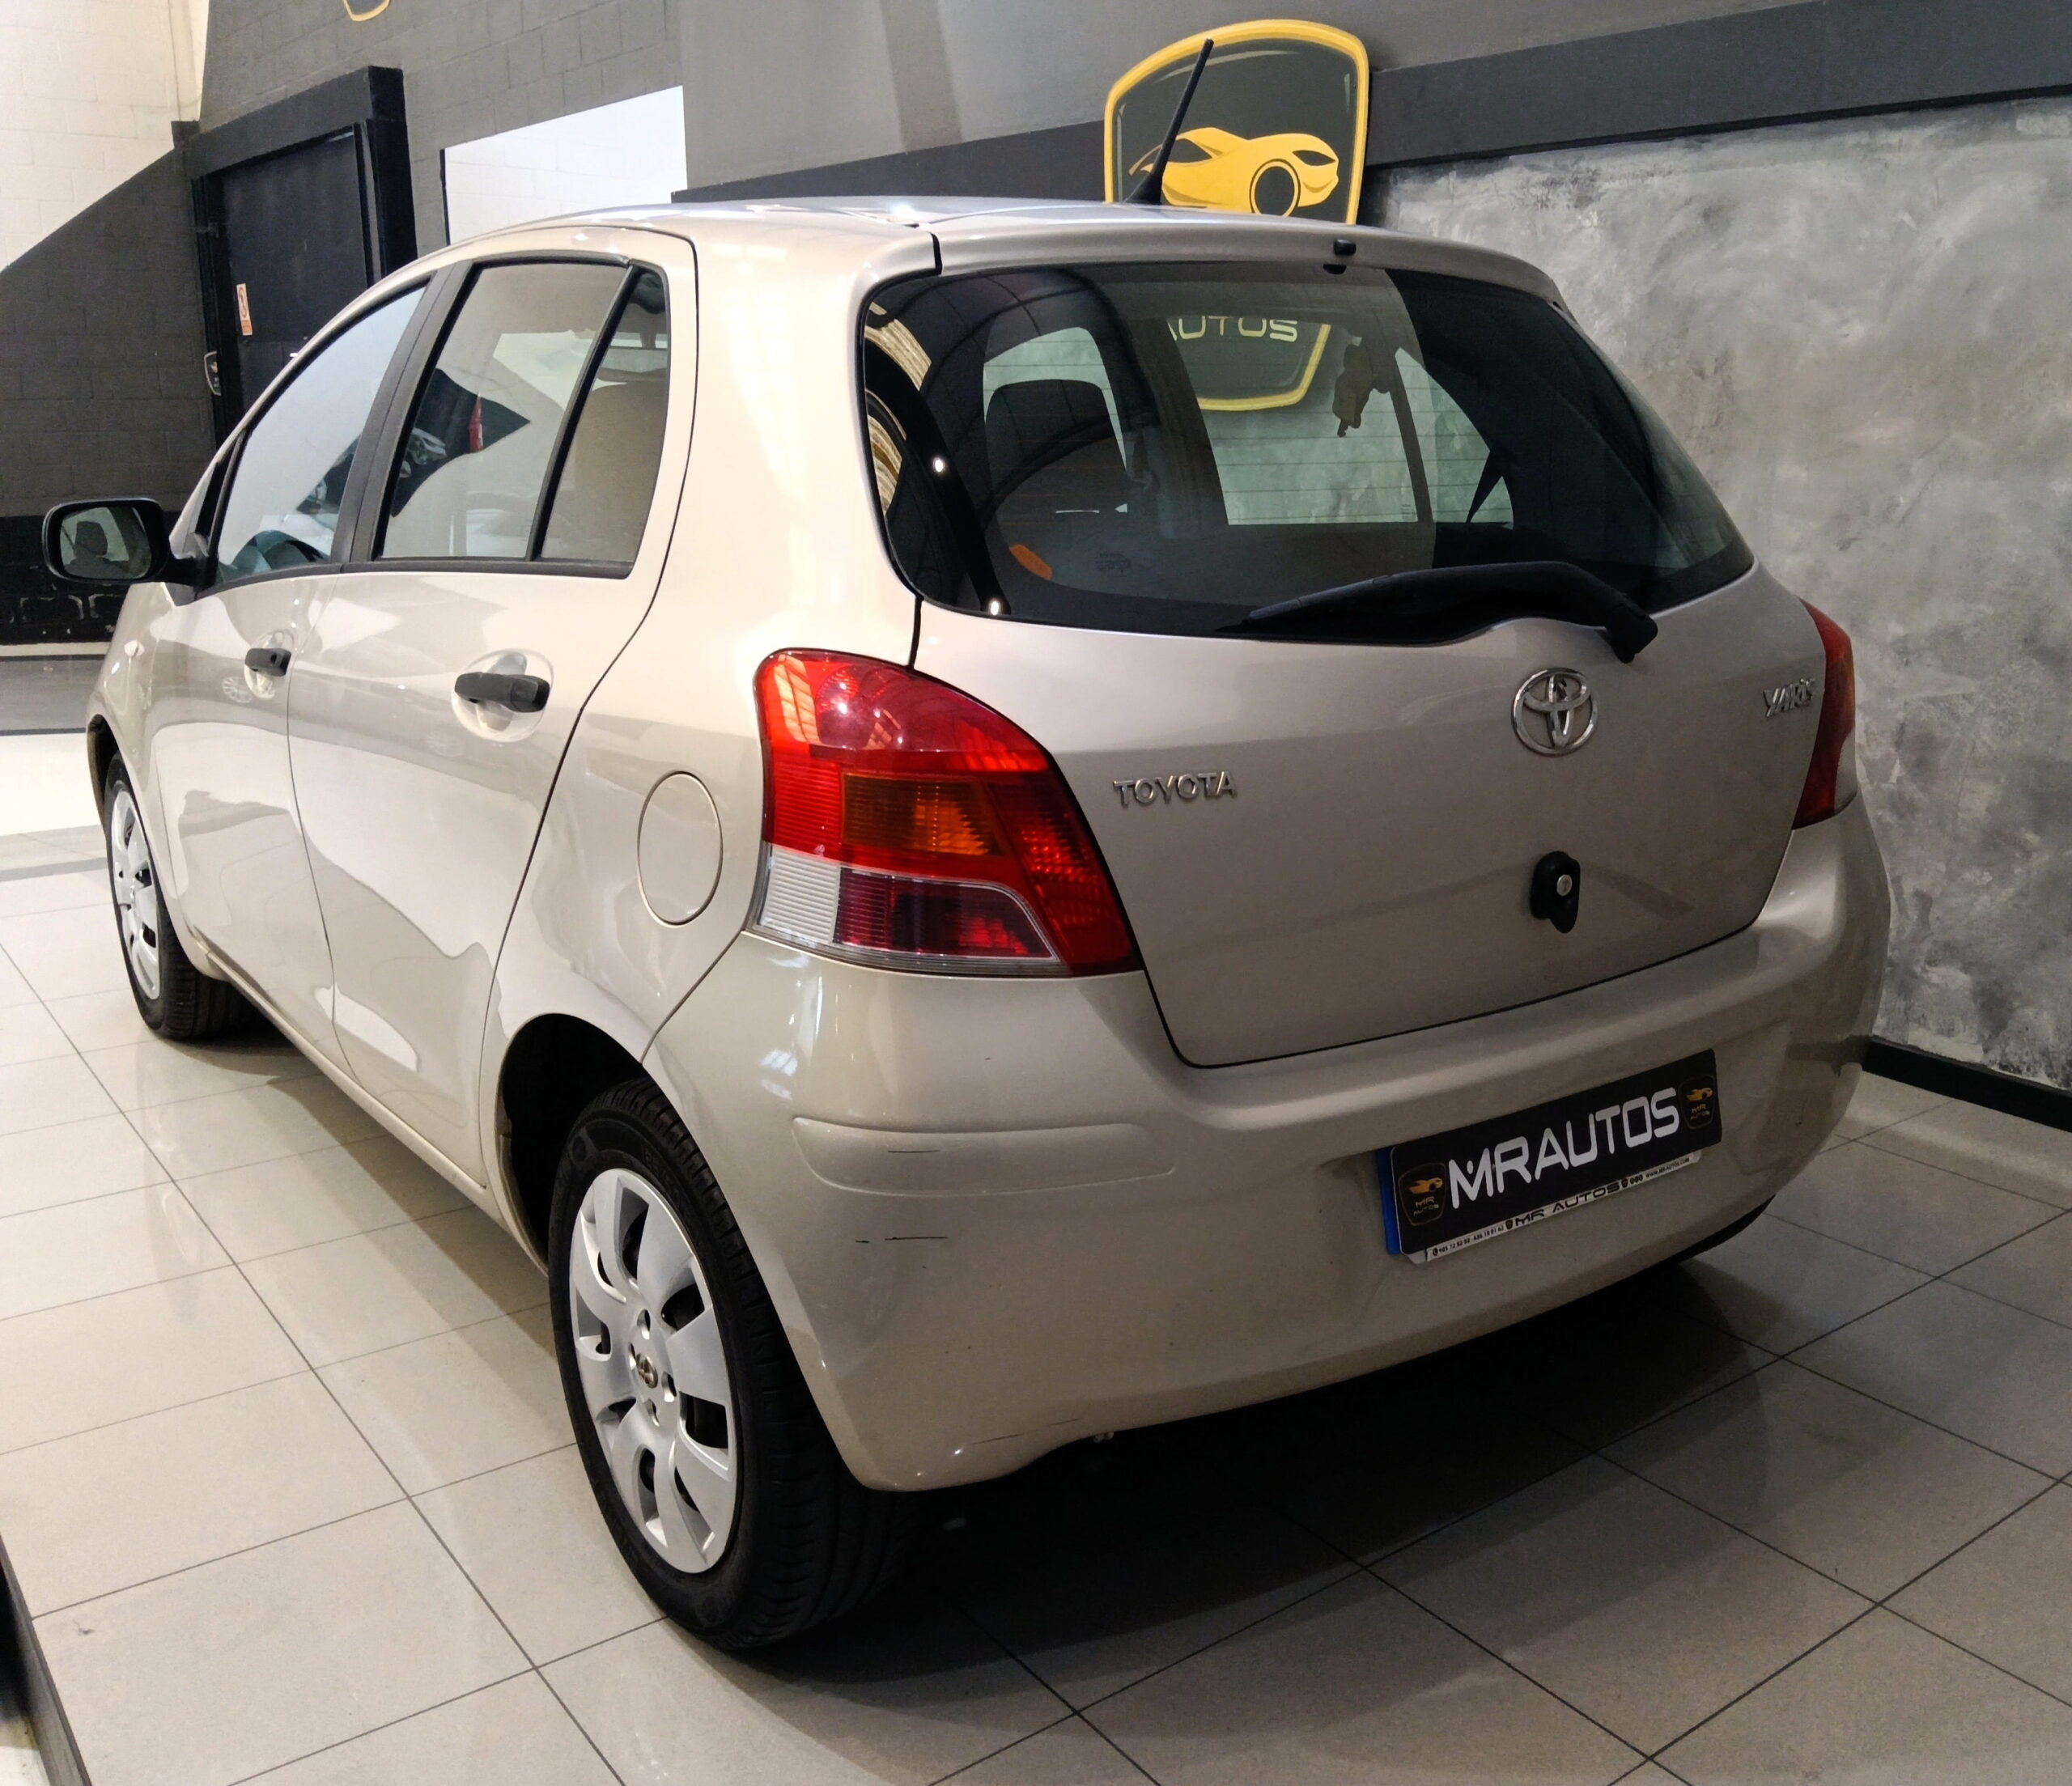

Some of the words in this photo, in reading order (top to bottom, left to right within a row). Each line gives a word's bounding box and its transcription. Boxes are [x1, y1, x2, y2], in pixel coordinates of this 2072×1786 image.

[1113, 770, 1237, 808] TOYOTA
[1413, 1203, 1440, 1217] AUTOS
[1416, 1196, 1435, 1208] MR
[1515, 1209, 1545, 1226] MR
[1552, 1181, 1620, 1214] AUTOS
